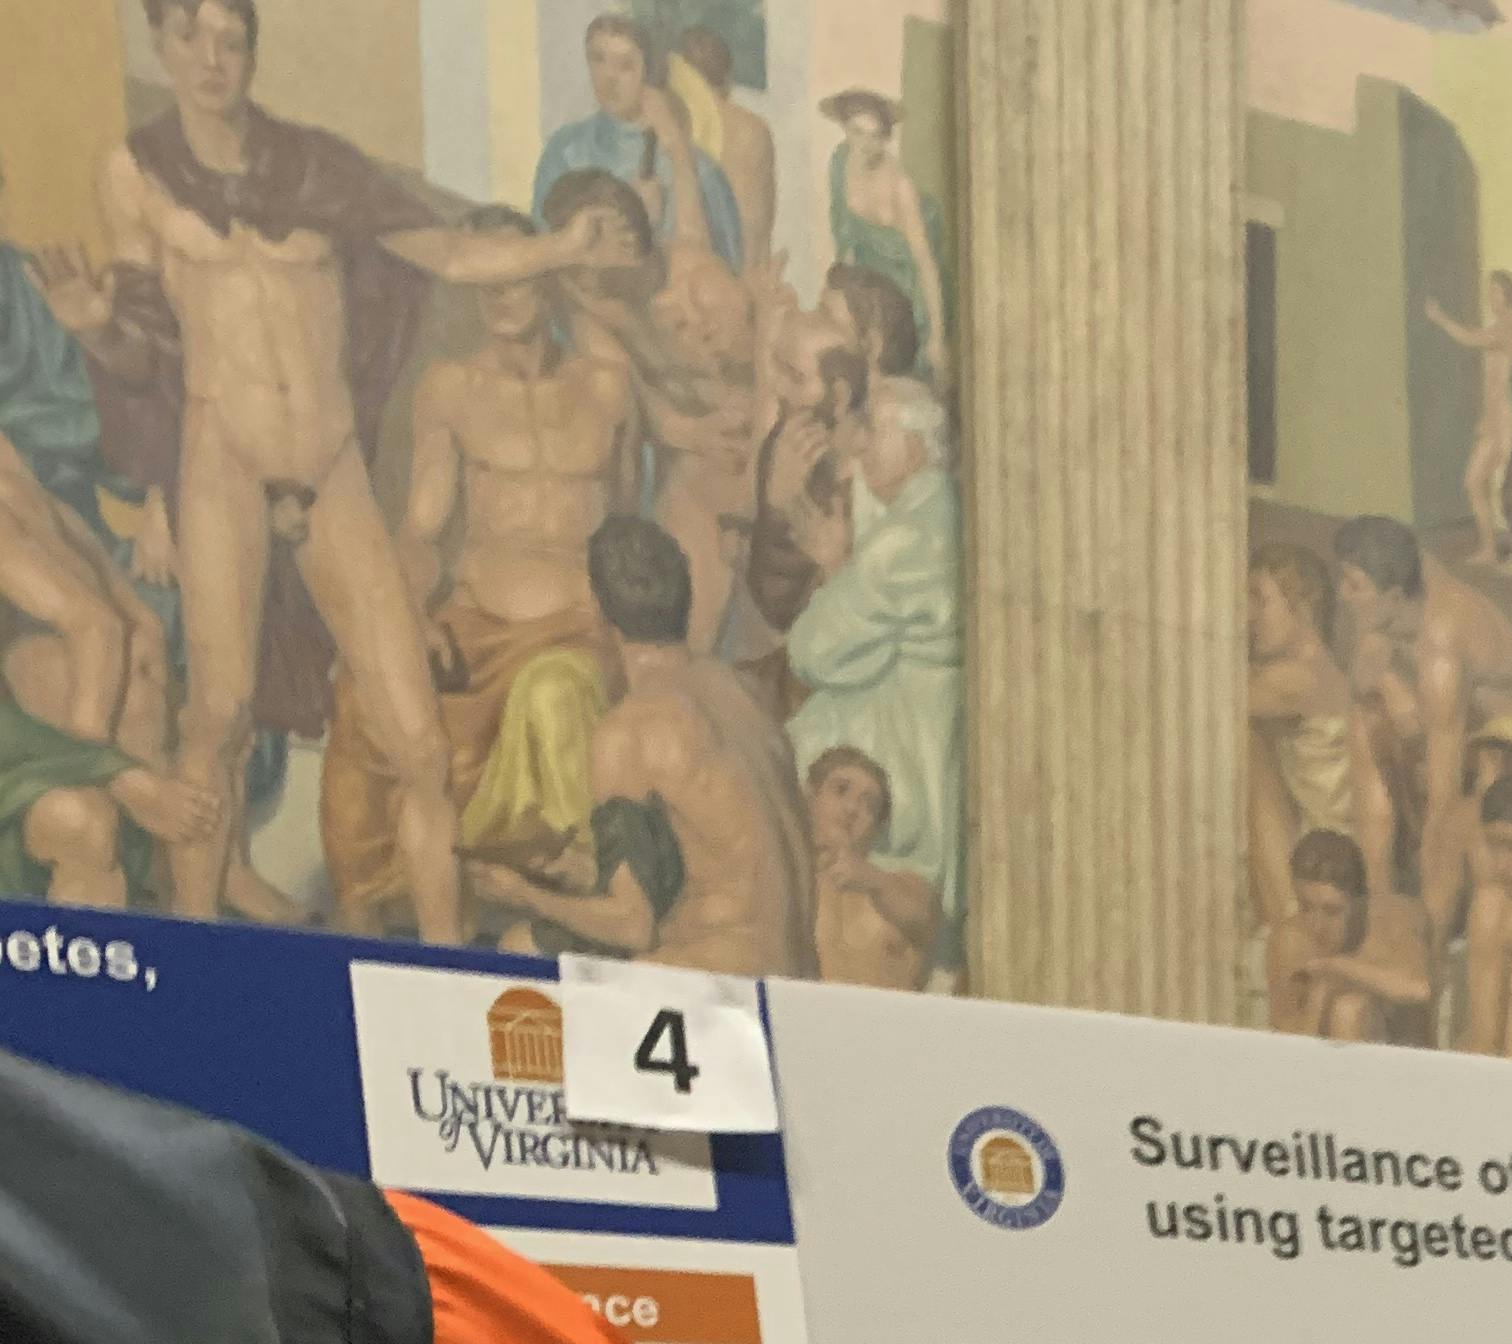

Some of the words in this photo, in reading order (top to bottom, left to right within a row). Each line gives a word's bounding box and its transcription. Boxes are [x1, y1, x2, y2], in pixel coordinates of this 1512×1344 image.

[0, 925, 157, 993] etes,
[634, 1007, 699, 1094] 4
[465, 1112, 658, 1176] VIRGINIA
[1129, 1115, 1463, 1192] Surveillance
[1146, 1194, 1301, 1260] using
